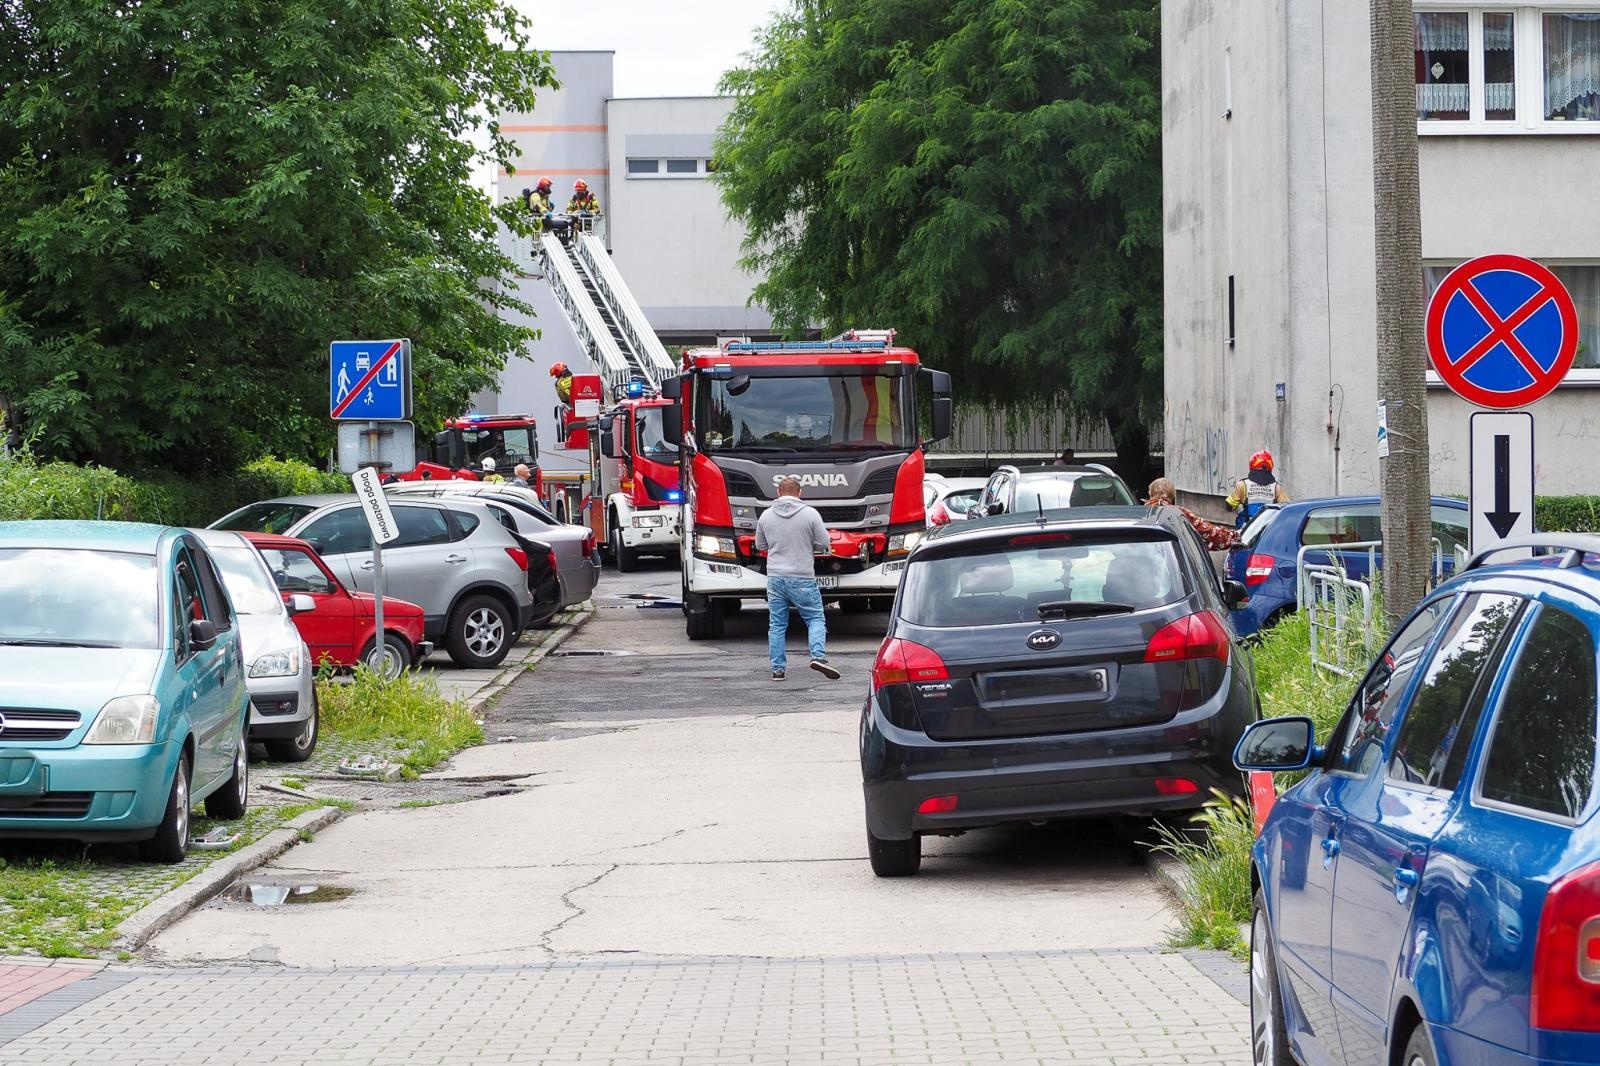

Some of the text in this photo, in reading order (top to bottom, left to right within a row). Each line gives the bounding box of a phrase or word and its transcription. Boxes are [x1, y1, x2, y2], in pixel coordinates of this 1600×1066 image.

[360, 472, 391, 539] Droga pożarowa
[1032, 635, 1055, 644] KIA
